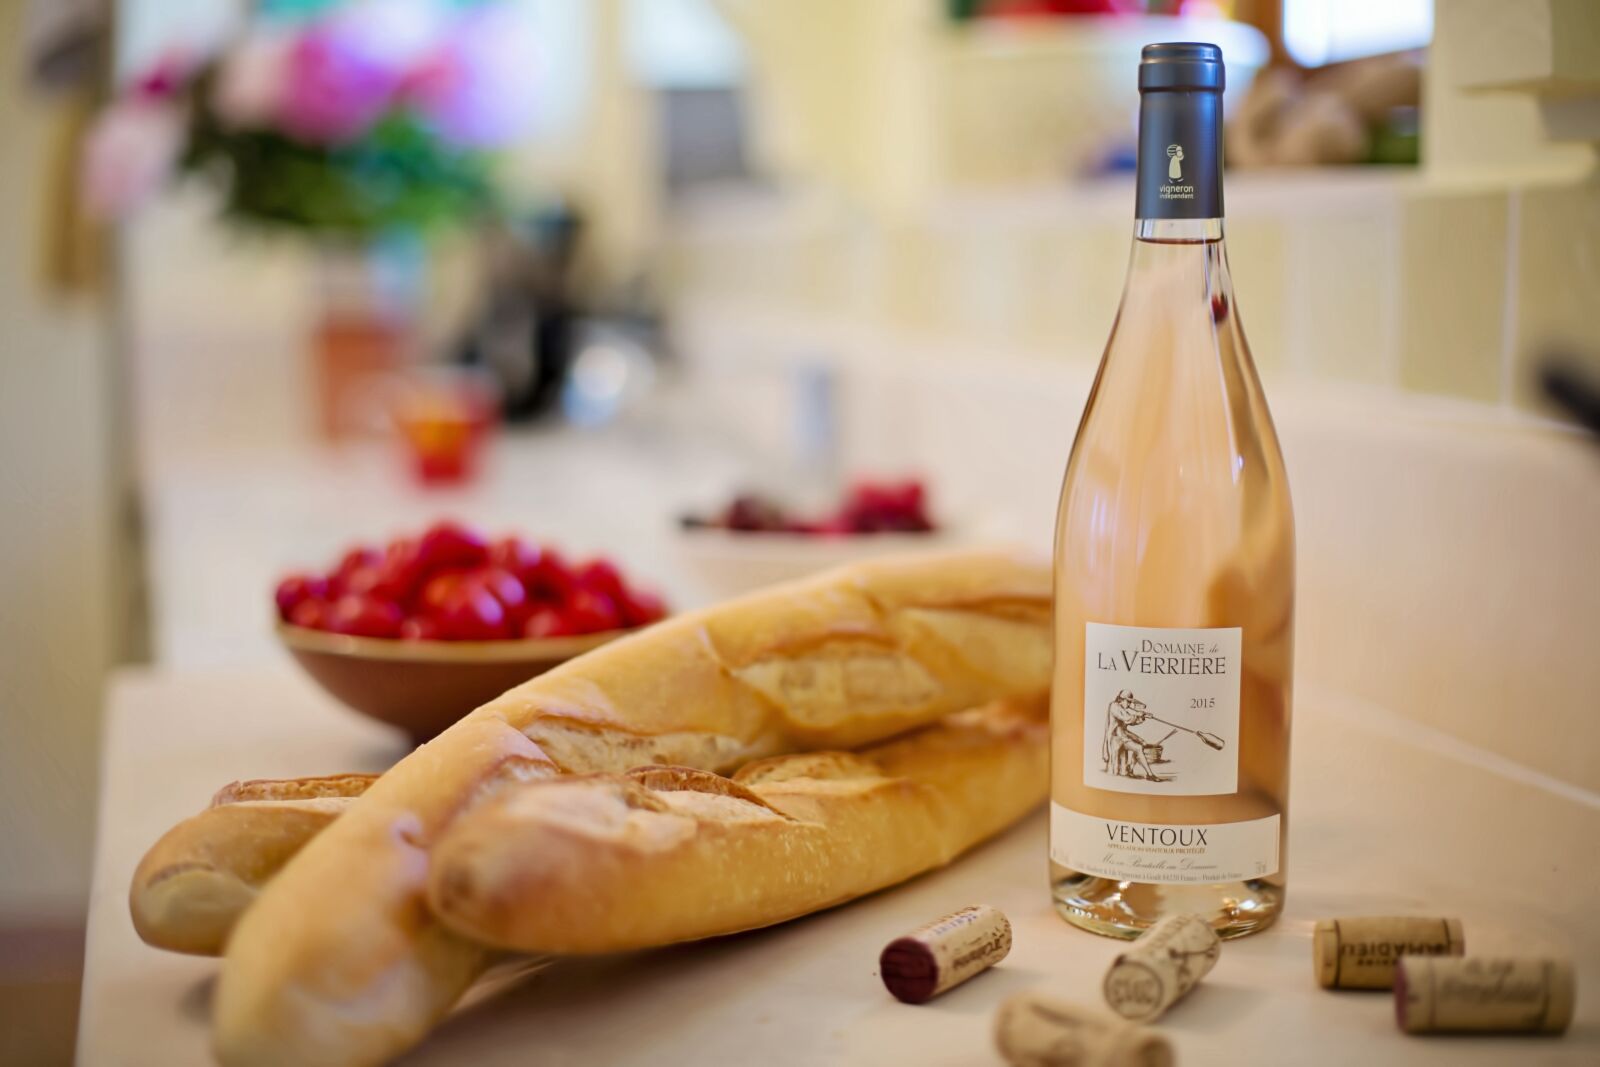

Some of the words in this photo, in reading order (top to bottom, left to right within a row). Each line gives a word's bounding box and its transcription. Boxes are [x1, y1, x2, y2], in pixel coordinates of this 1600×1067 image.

[1159, 184, 1194, 193] vigneron
[1142, 639, 1205, 654] DOMAINE
[1208, 643, 1220, 653] de
[1098, 652, 1117, 671] LA
[1122, 650, 1226, 675] VERRIÈRE
[1190, 698, 1216, 709] 2015
[1106, 823, 1208, 847] VENTOUX
